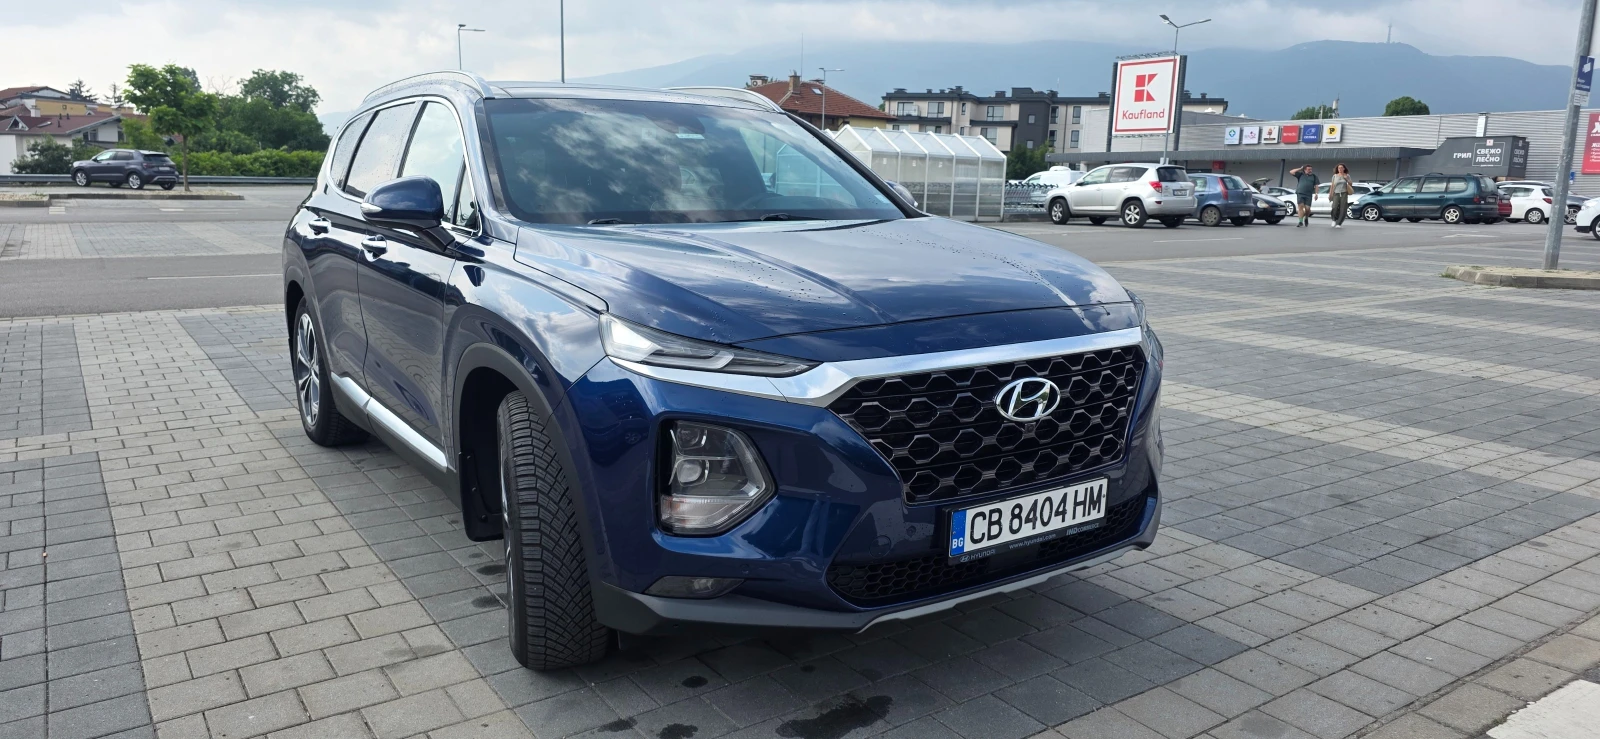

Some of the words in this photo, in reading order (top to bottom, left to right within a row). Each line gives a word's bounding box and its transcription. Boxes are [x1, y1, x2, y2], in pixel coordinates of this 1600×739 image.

[1122, 108, 1165, 120] Kaufland
[969, 507, 1003, 545] CB
[1008, 492, 1068, 535] 8404
[1072, 483, 1103, 520] HM
[952, 537, 964, 549] BG
[1008, 533, 1056, 549] www.hyundai.com
[970, 548, 996, 560] HYUNDAI
